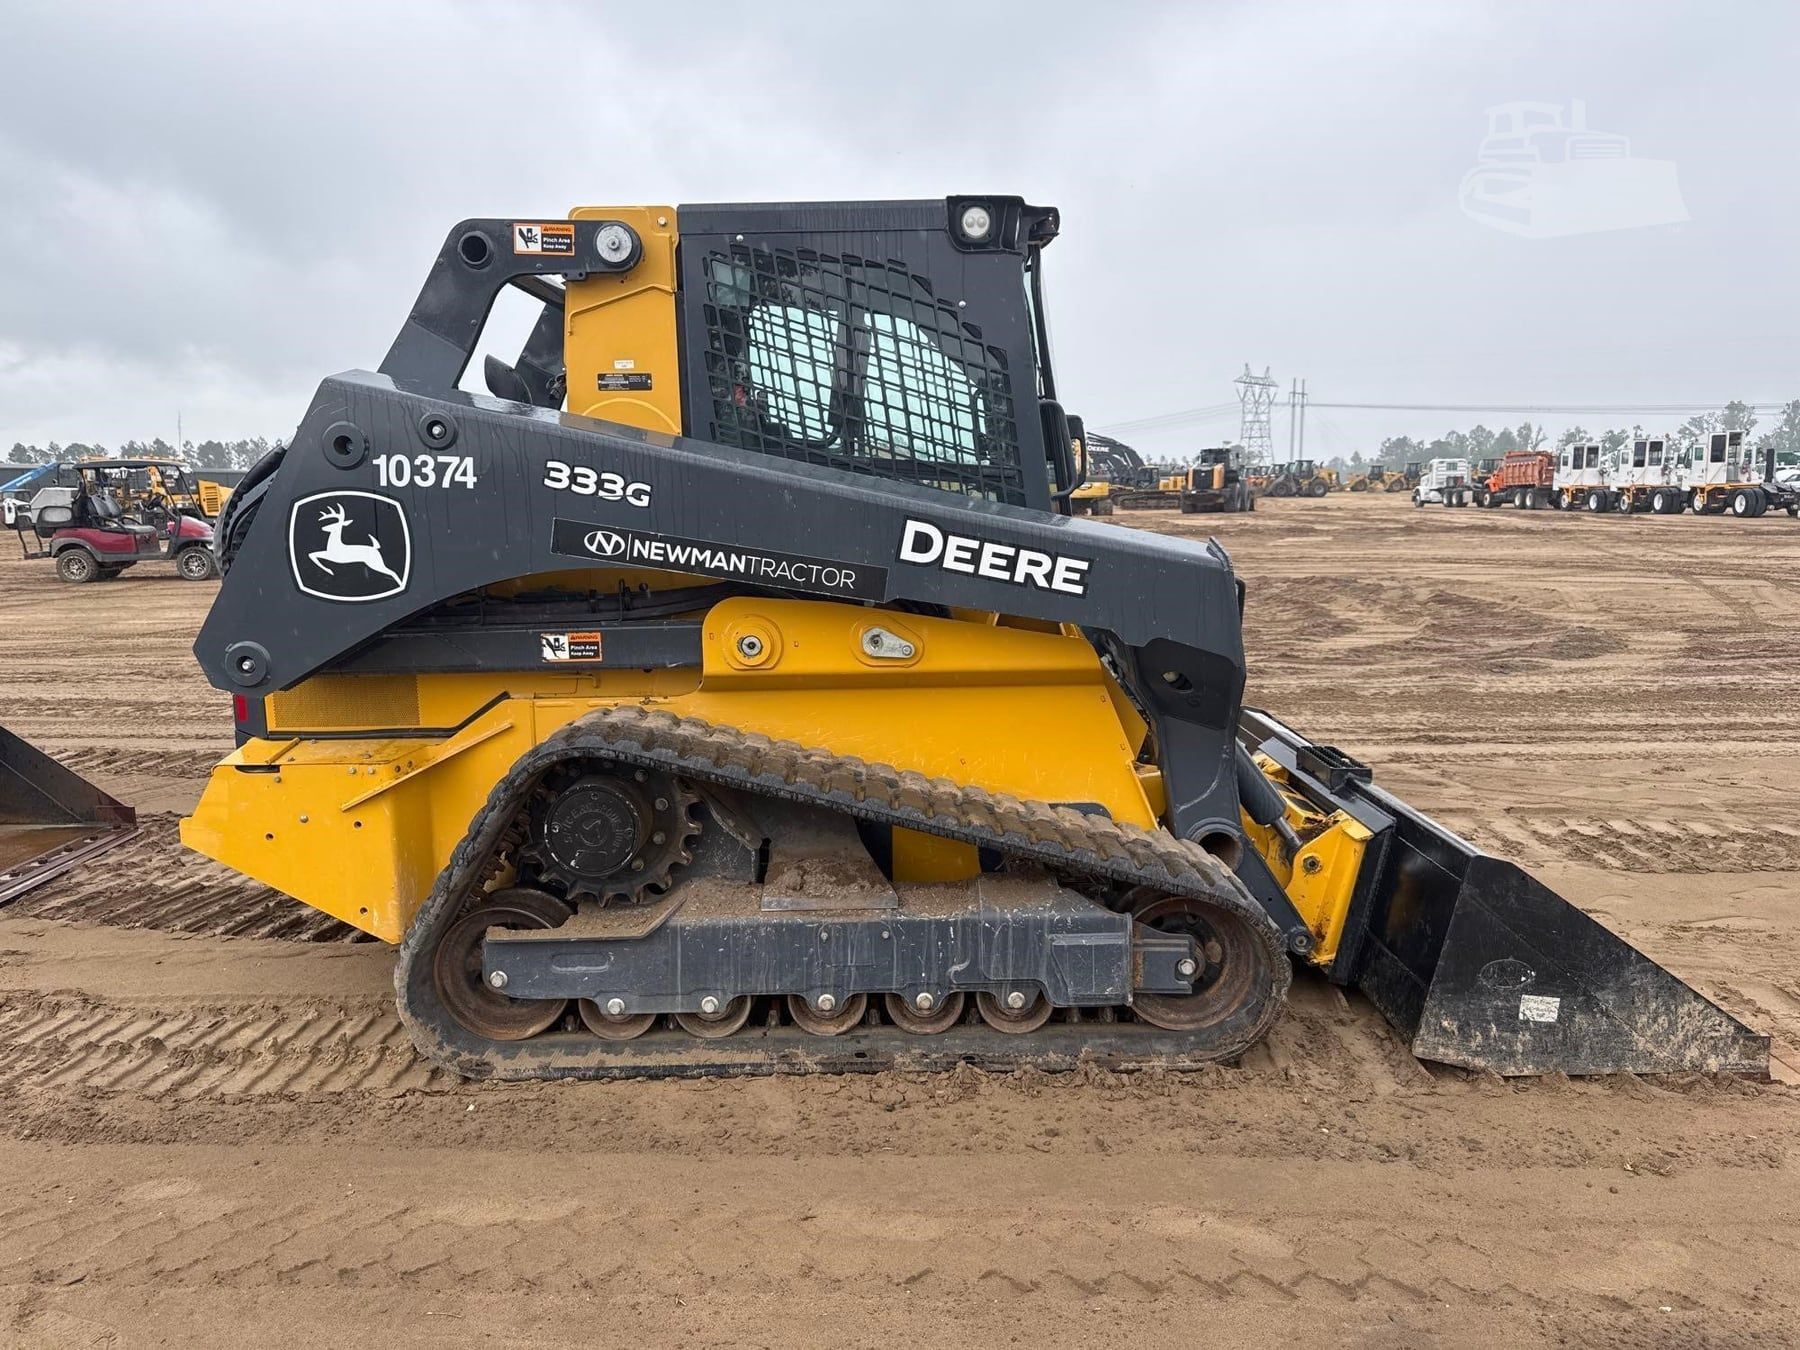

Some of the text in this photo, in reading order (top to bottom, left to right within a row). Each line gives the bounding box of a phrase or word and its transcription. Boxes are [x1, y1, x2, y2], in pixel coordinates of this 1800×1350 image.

[372, 454, 478, 489] 10374
[543, 461, 652, 508] 333G
[899, 519, 1090, 595] DEERE
